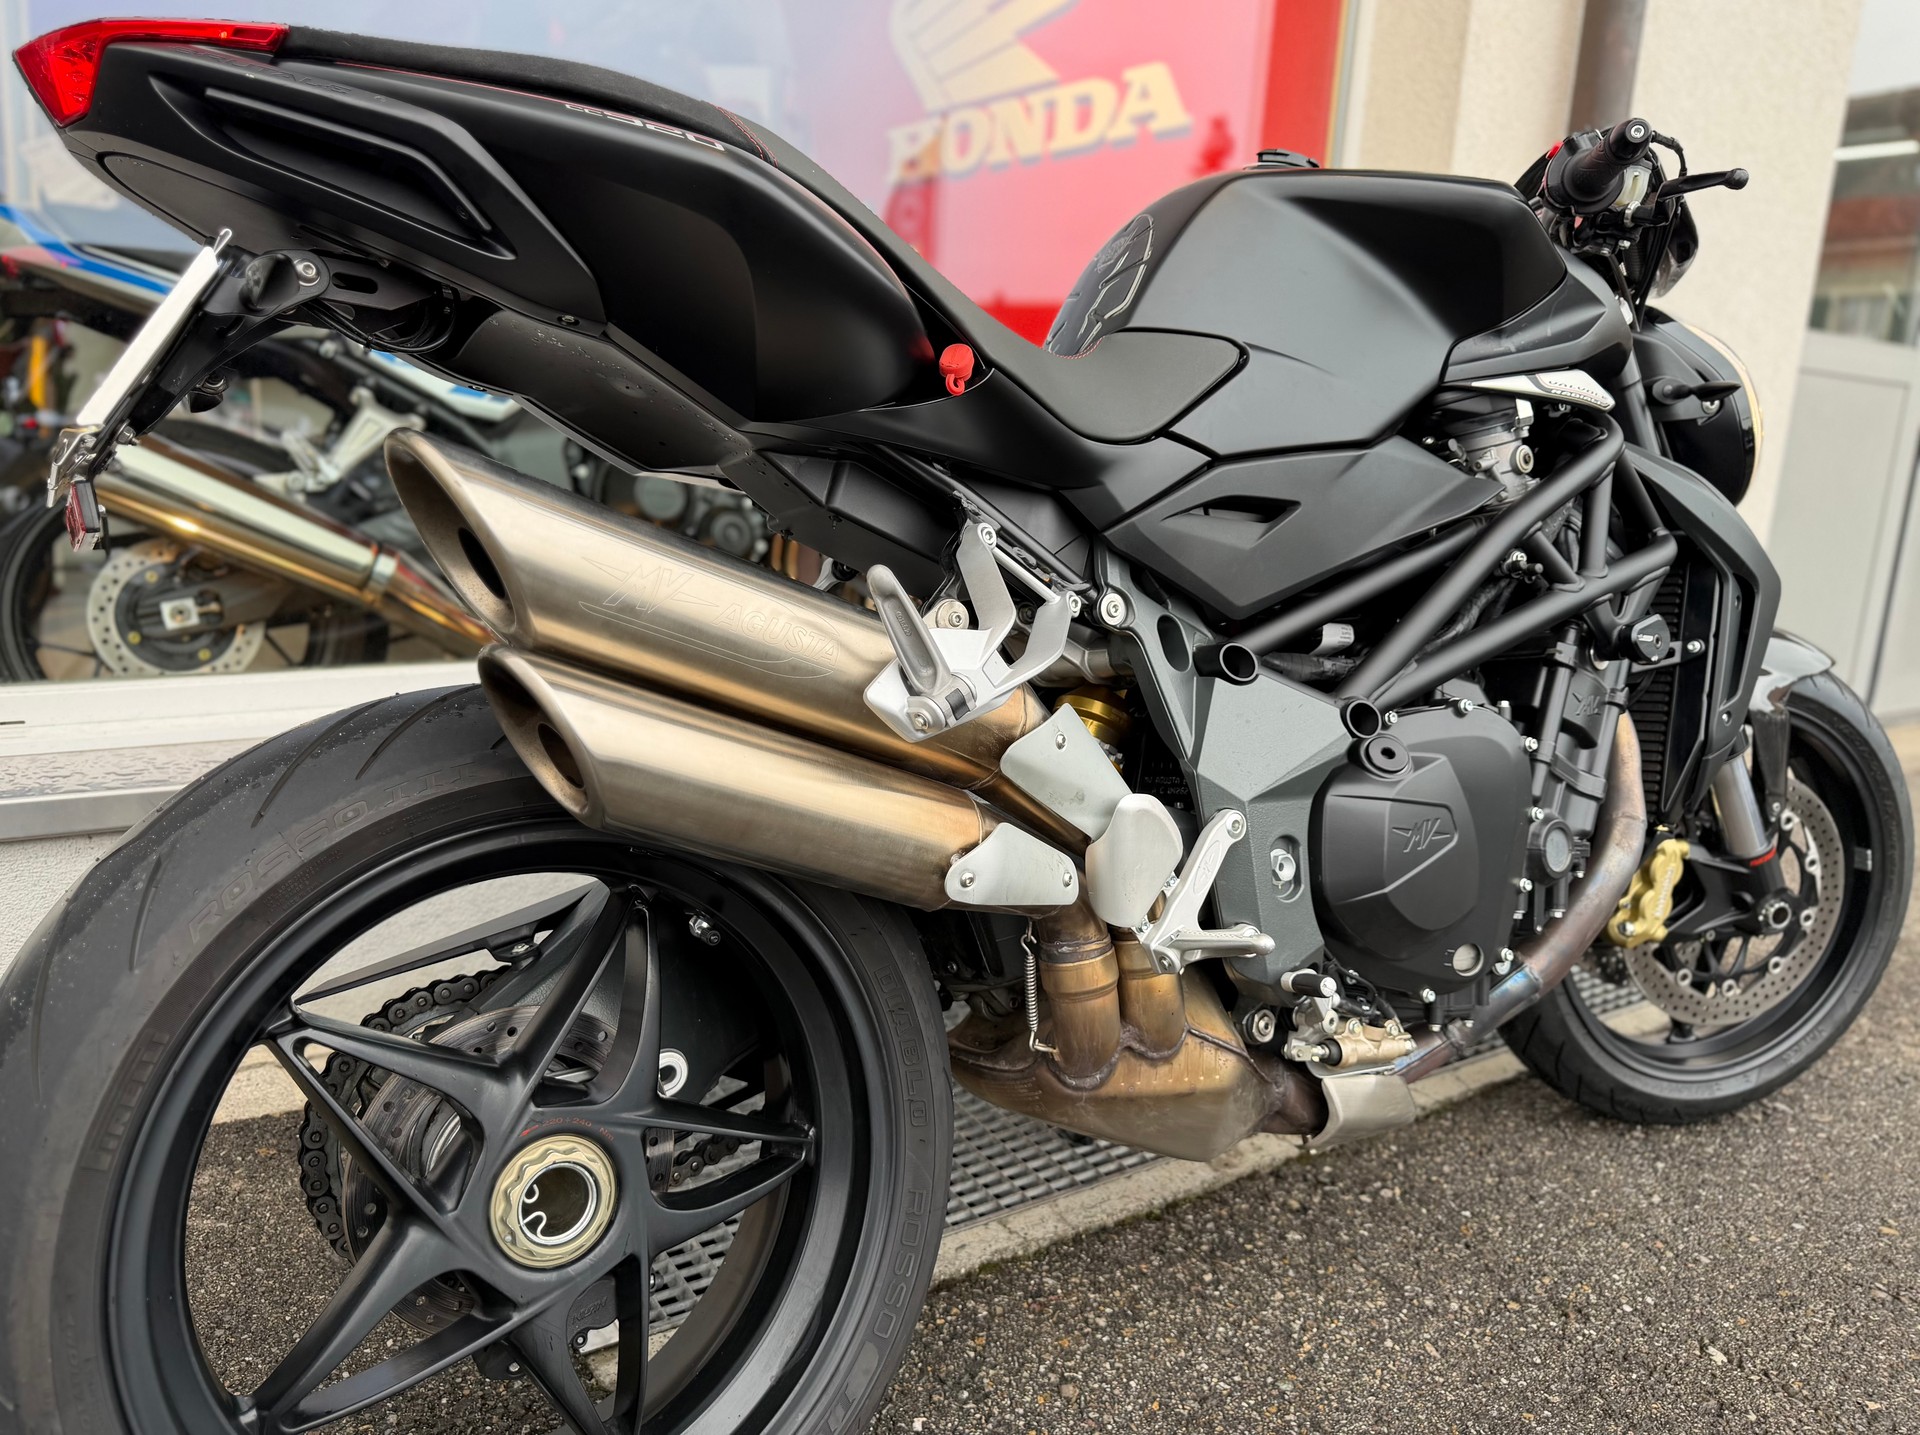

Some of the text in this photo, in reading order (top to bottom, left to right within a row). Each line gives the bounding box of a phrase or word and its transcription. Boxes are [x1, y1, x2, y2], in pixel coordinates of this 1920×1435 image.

[886, 61, 1192, 184] HONDA
[602, 565, 696, 614] MV
[712, 602, 841, 666] AGUSTA
[188, 800, 369, 946] ROSSO
[1403, 817, 1441, 853] MV
[872, 963, 929, 1342] DIABLO ROSSO
